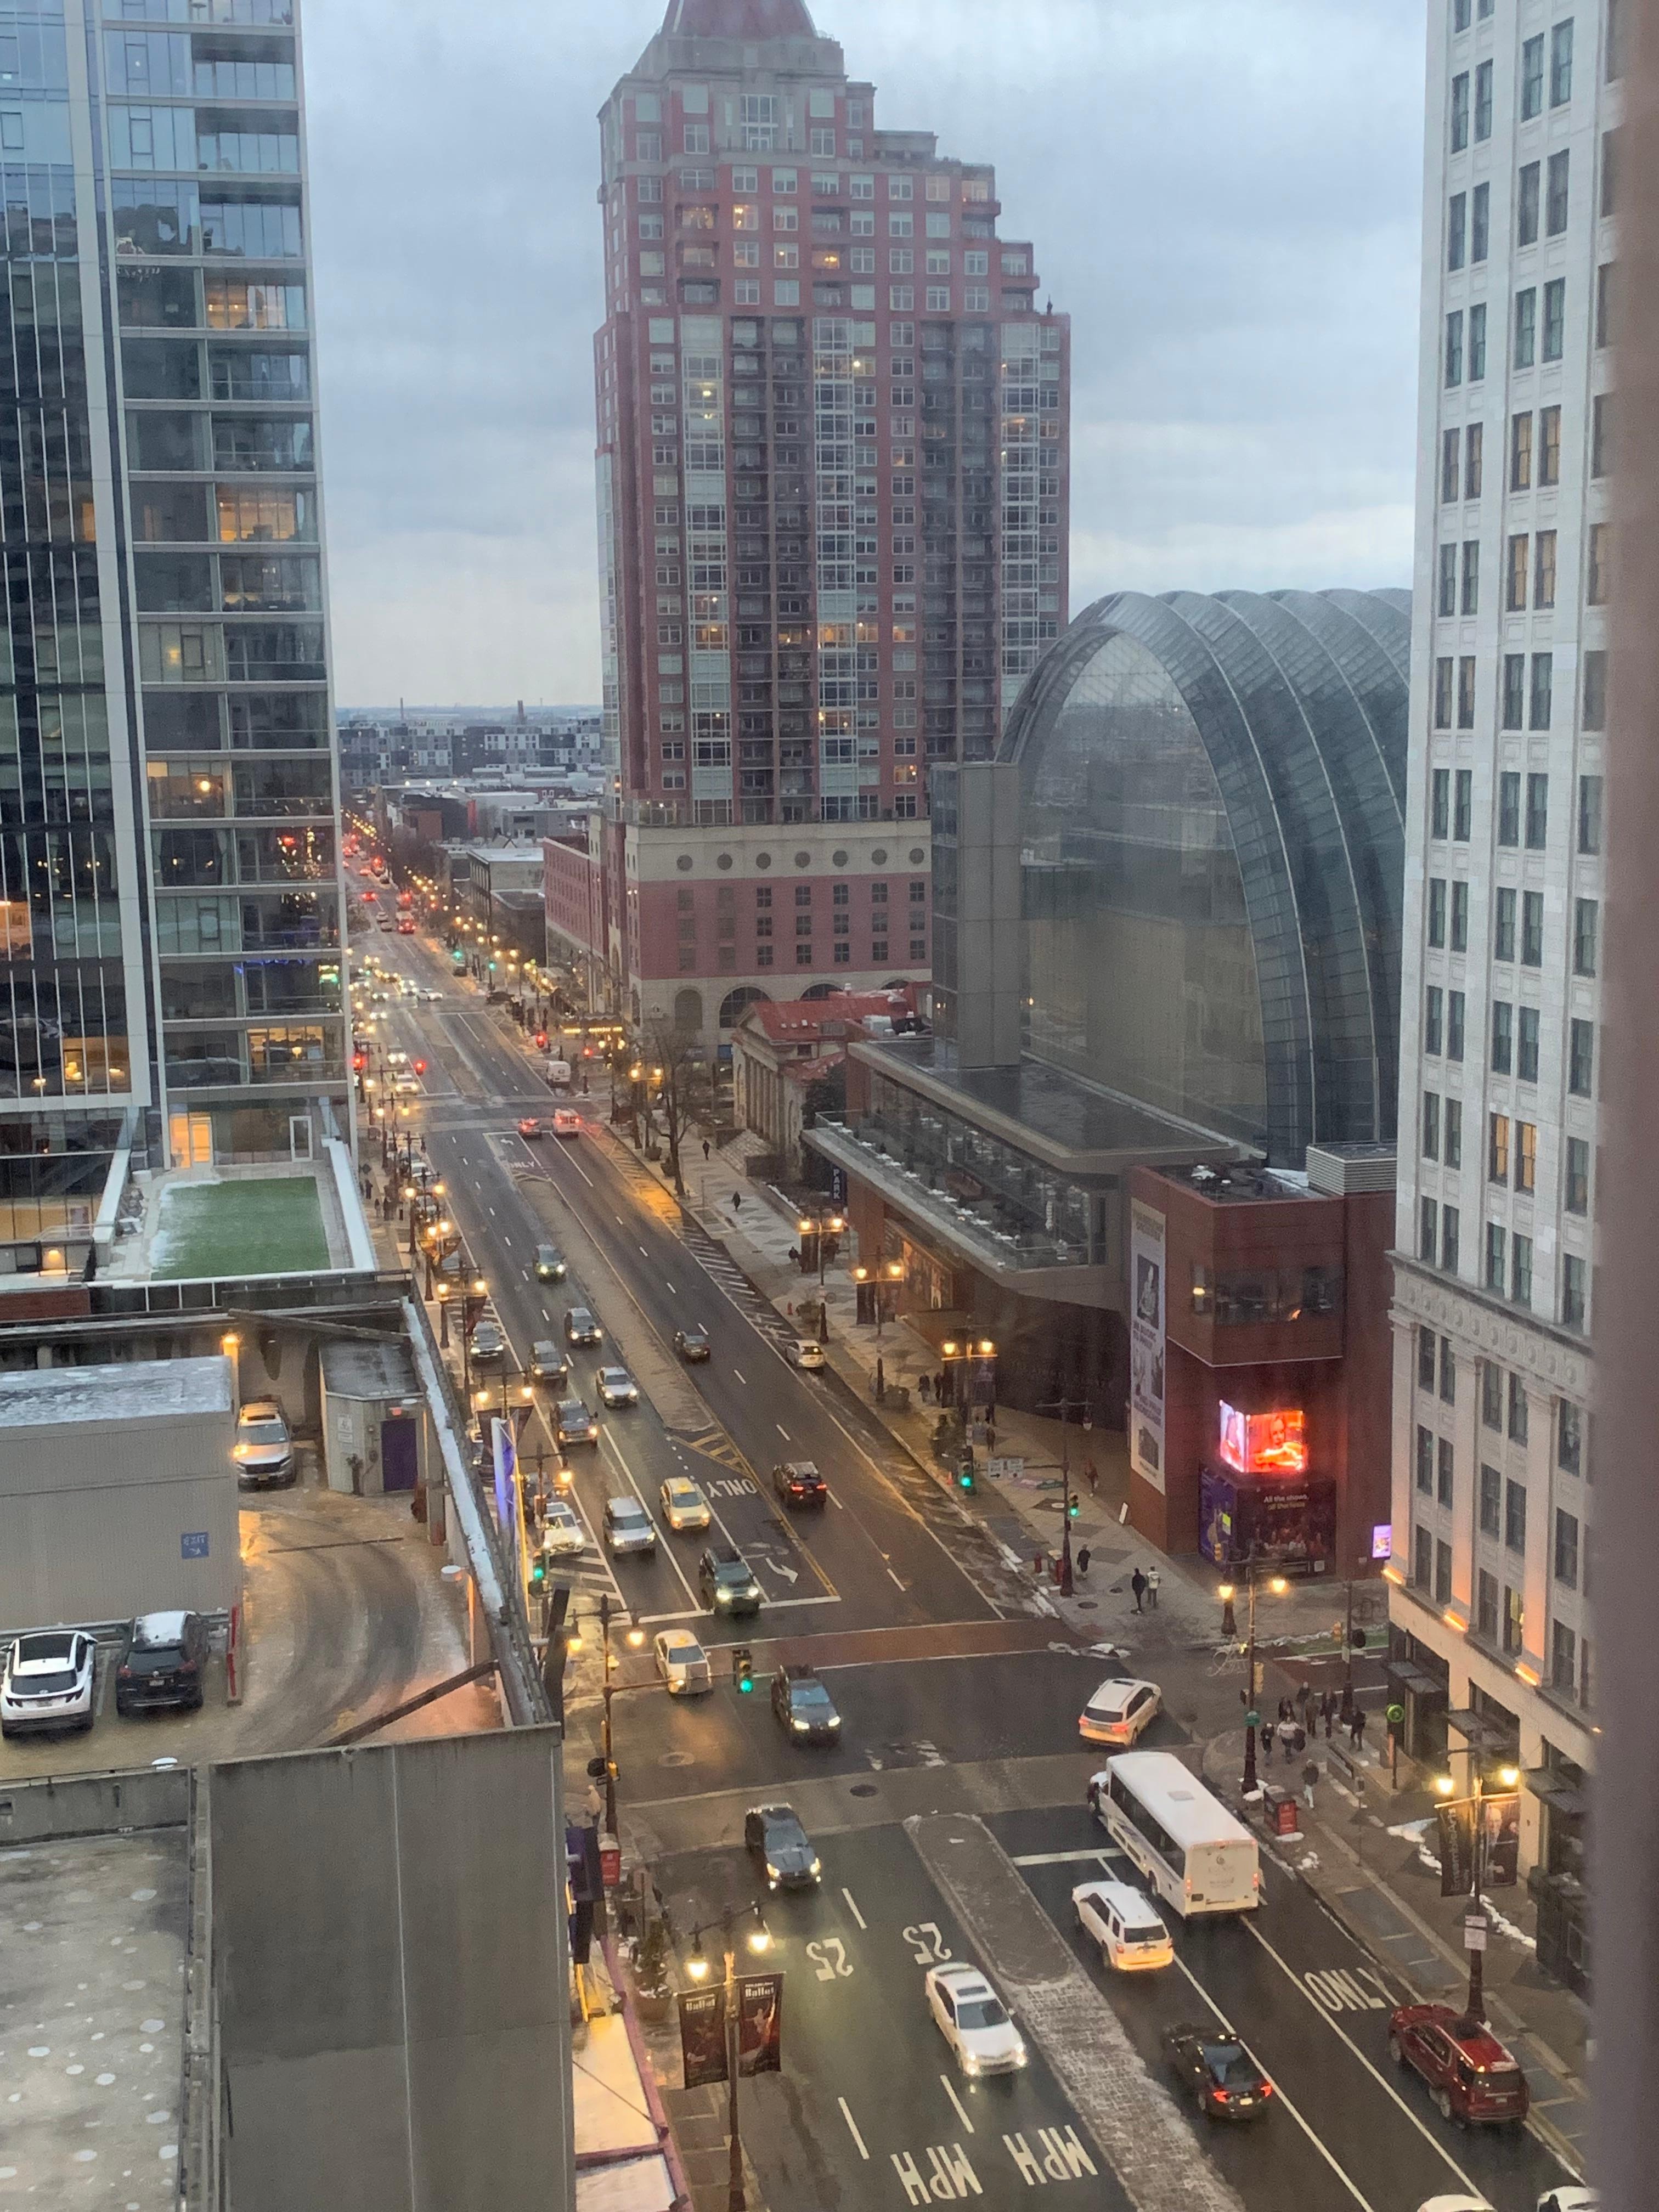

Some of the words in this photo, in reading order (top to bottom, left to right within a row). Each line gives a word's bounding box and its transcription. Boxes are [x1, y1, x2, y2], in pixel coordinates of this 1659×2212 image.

[707, 1478, 758, 1497] ONLY
[183, 1534, 205, 1546] EXIT
[806, 1938, 854, 1981] 25
[902, 1922, 952, 1965] 25
[745, 1987, 774, 1997] Ballet
[1304, 1967, 1400, 2011] ONLY
[890, 2143, 984, 2206] MPH
[1002, 2125, 1098, 2186] MPH
